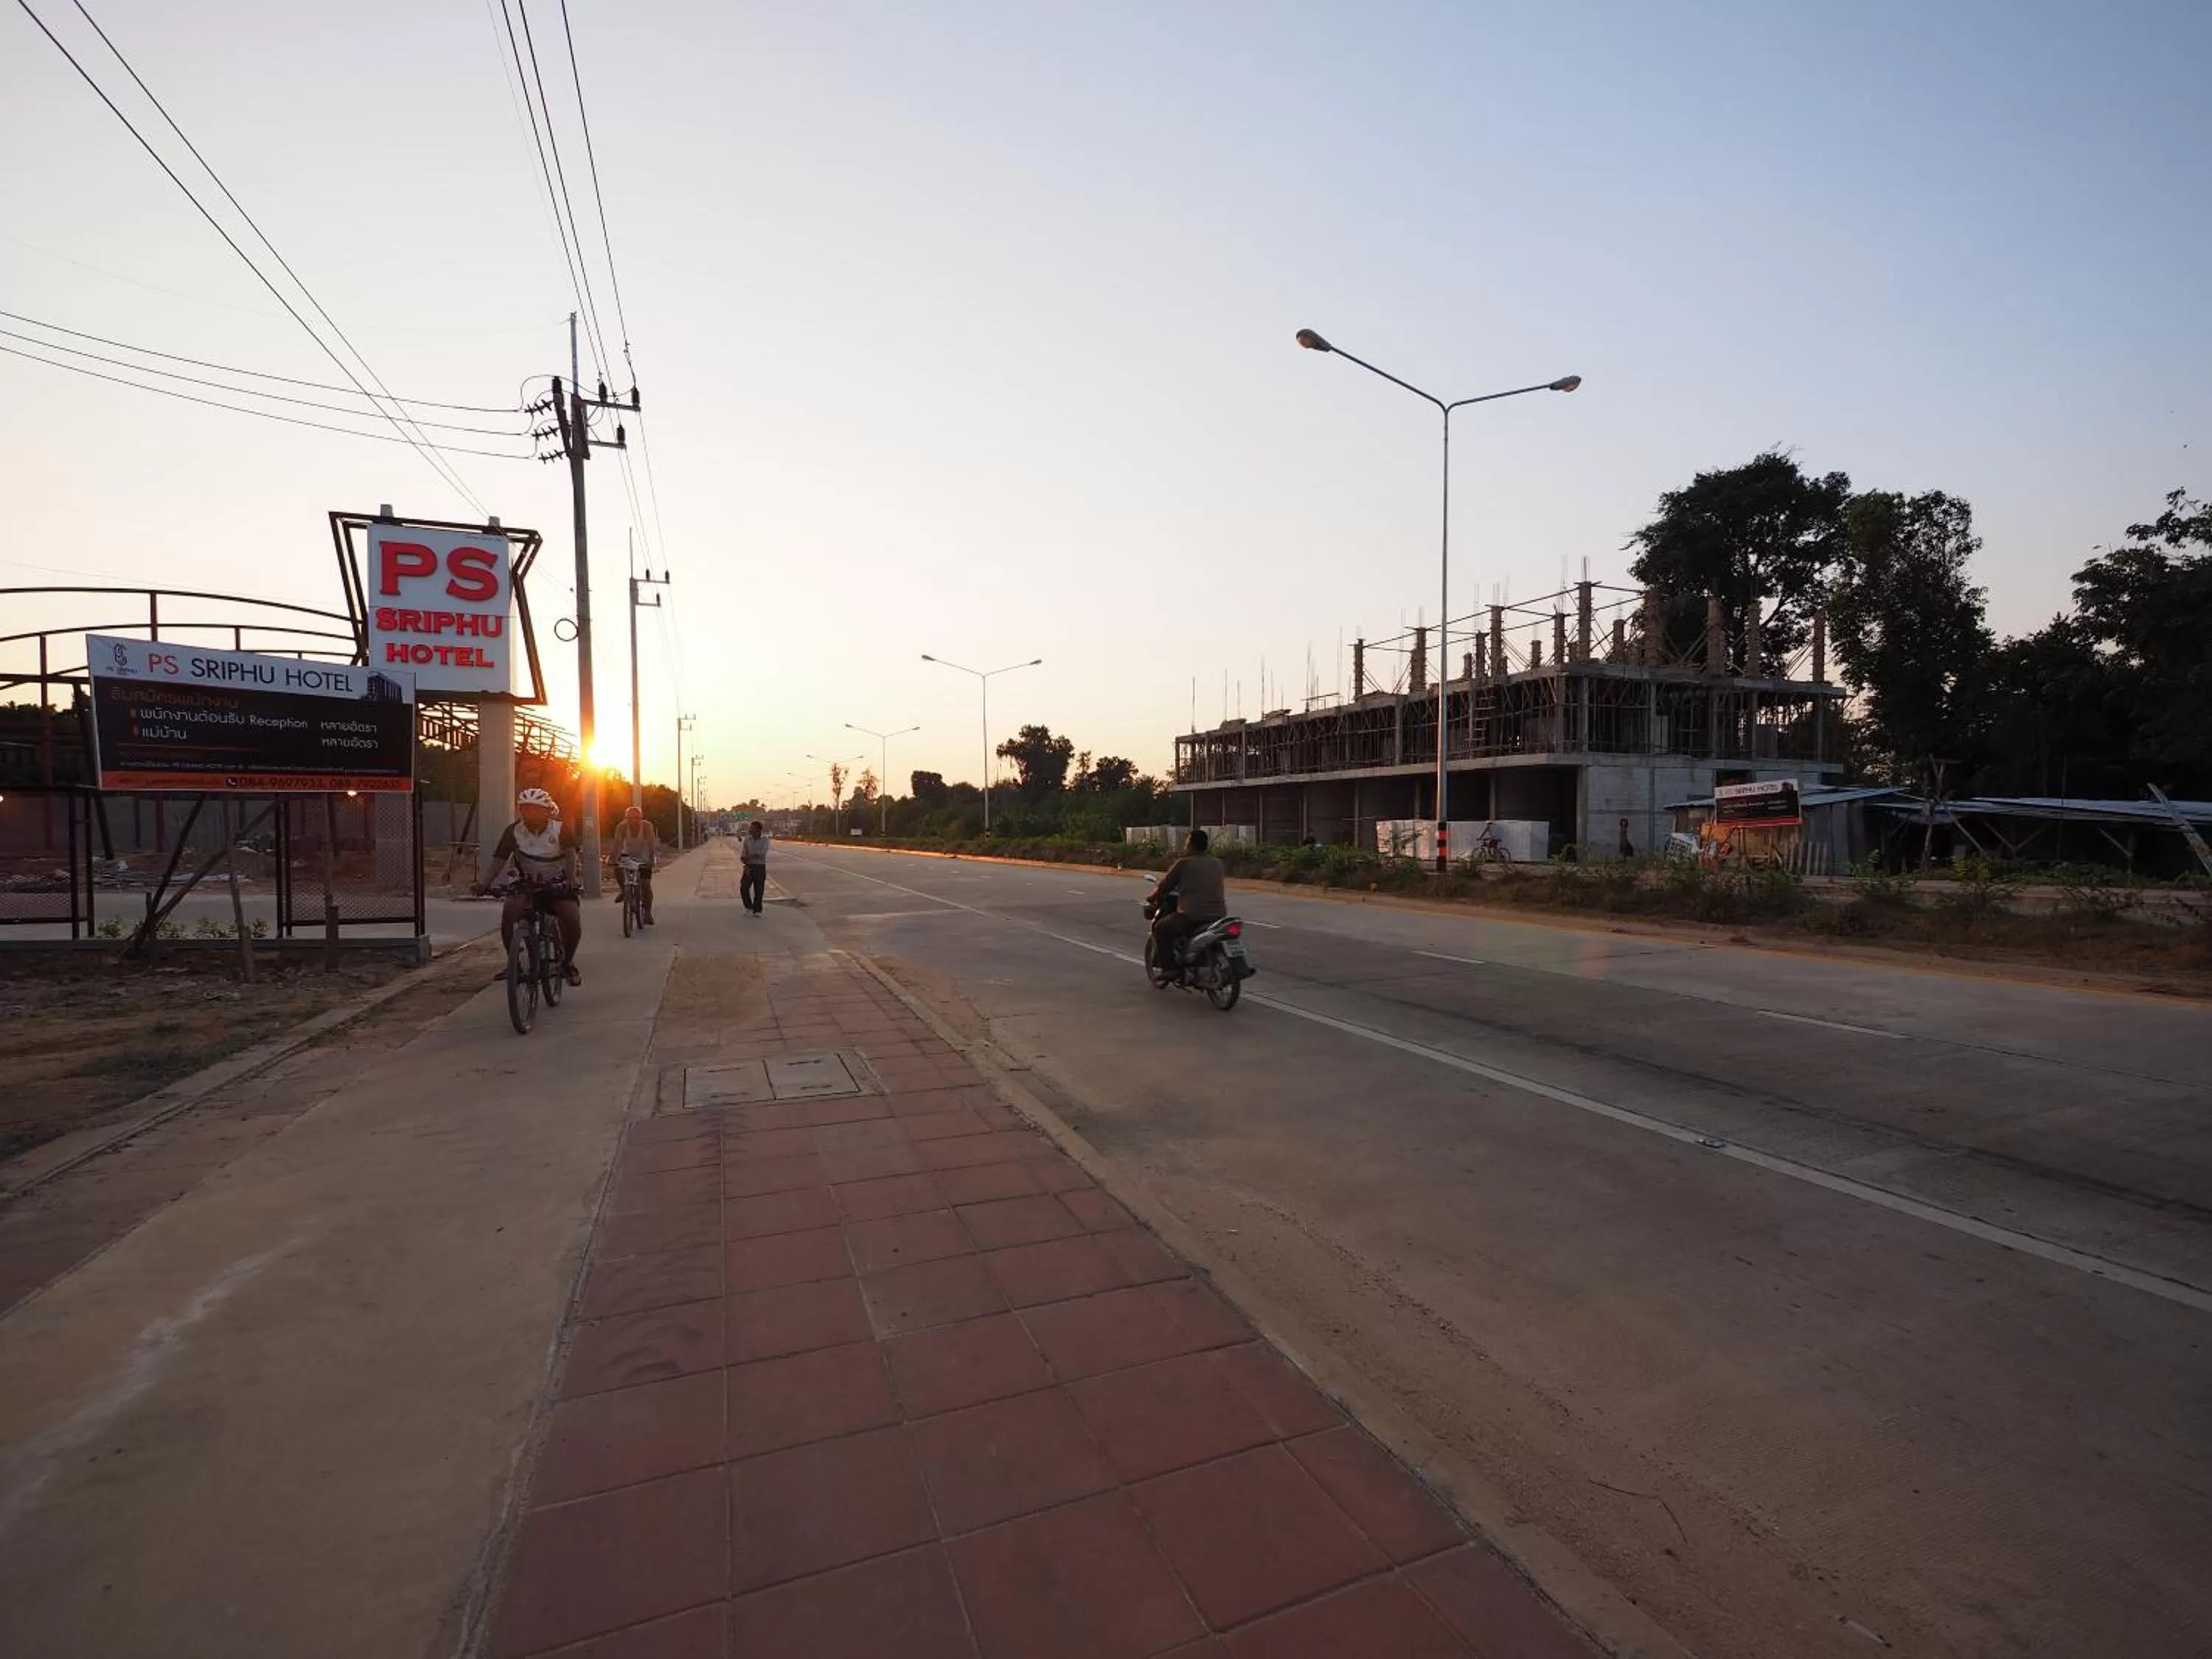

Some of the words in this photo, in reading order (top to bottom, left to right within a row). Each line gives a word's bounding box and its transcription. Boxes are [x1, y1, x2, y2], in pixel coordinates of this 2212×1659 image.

[378, 540, 499, 602] PS
[376, 607, 504, 638] SRIPHU
[385, 641, 495, 668] HOTEL
[148, 653, 179, 674] PS
[190, 658, 275, 684] SRIPHU
[285, 667, 353, 692] HOTEL
[249, 714, 308, 729] Reception
